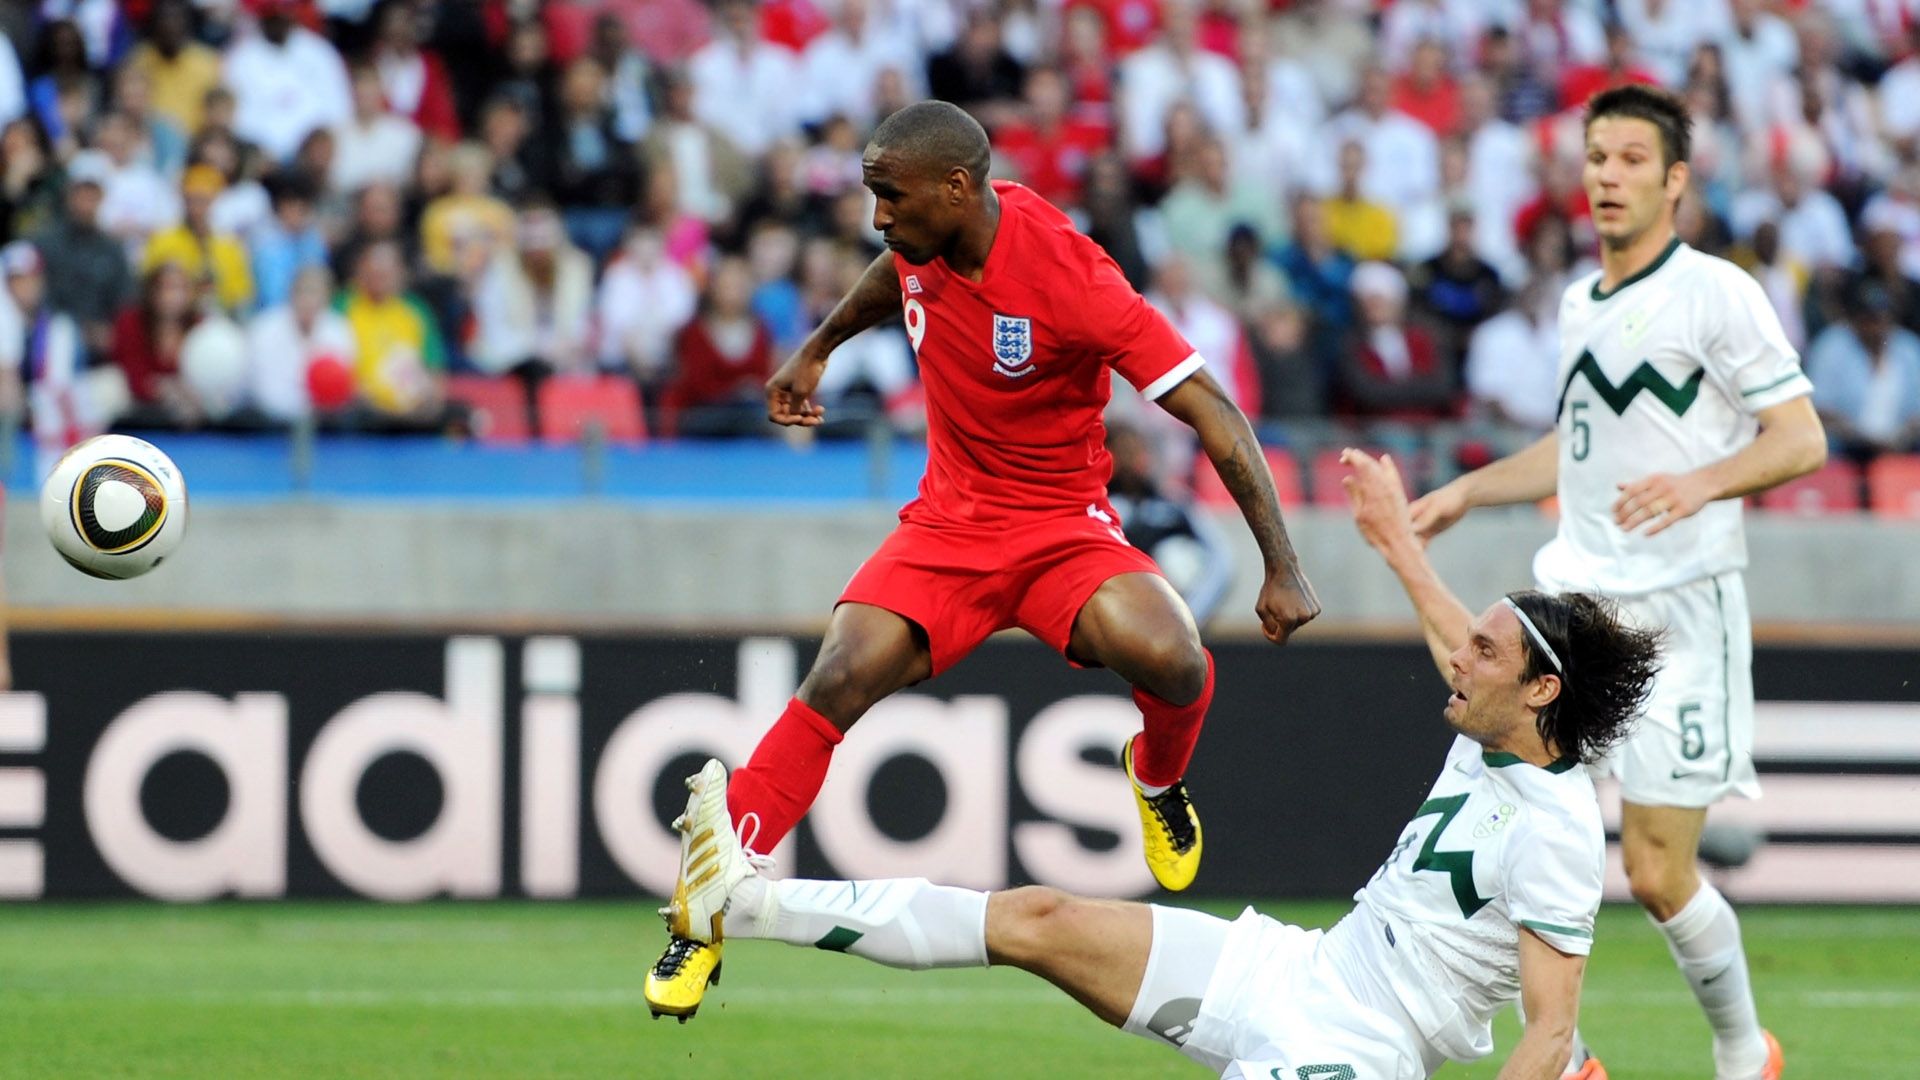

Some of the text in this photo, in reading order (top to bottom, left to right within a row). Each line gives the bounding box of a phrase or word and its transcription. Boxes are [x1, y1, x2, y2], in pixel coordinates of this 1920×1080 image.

[1571, 401, 1590, 462] 5
[1679, 702, 1705, 760] 5
[83, 637, 1164, 902] adidas
